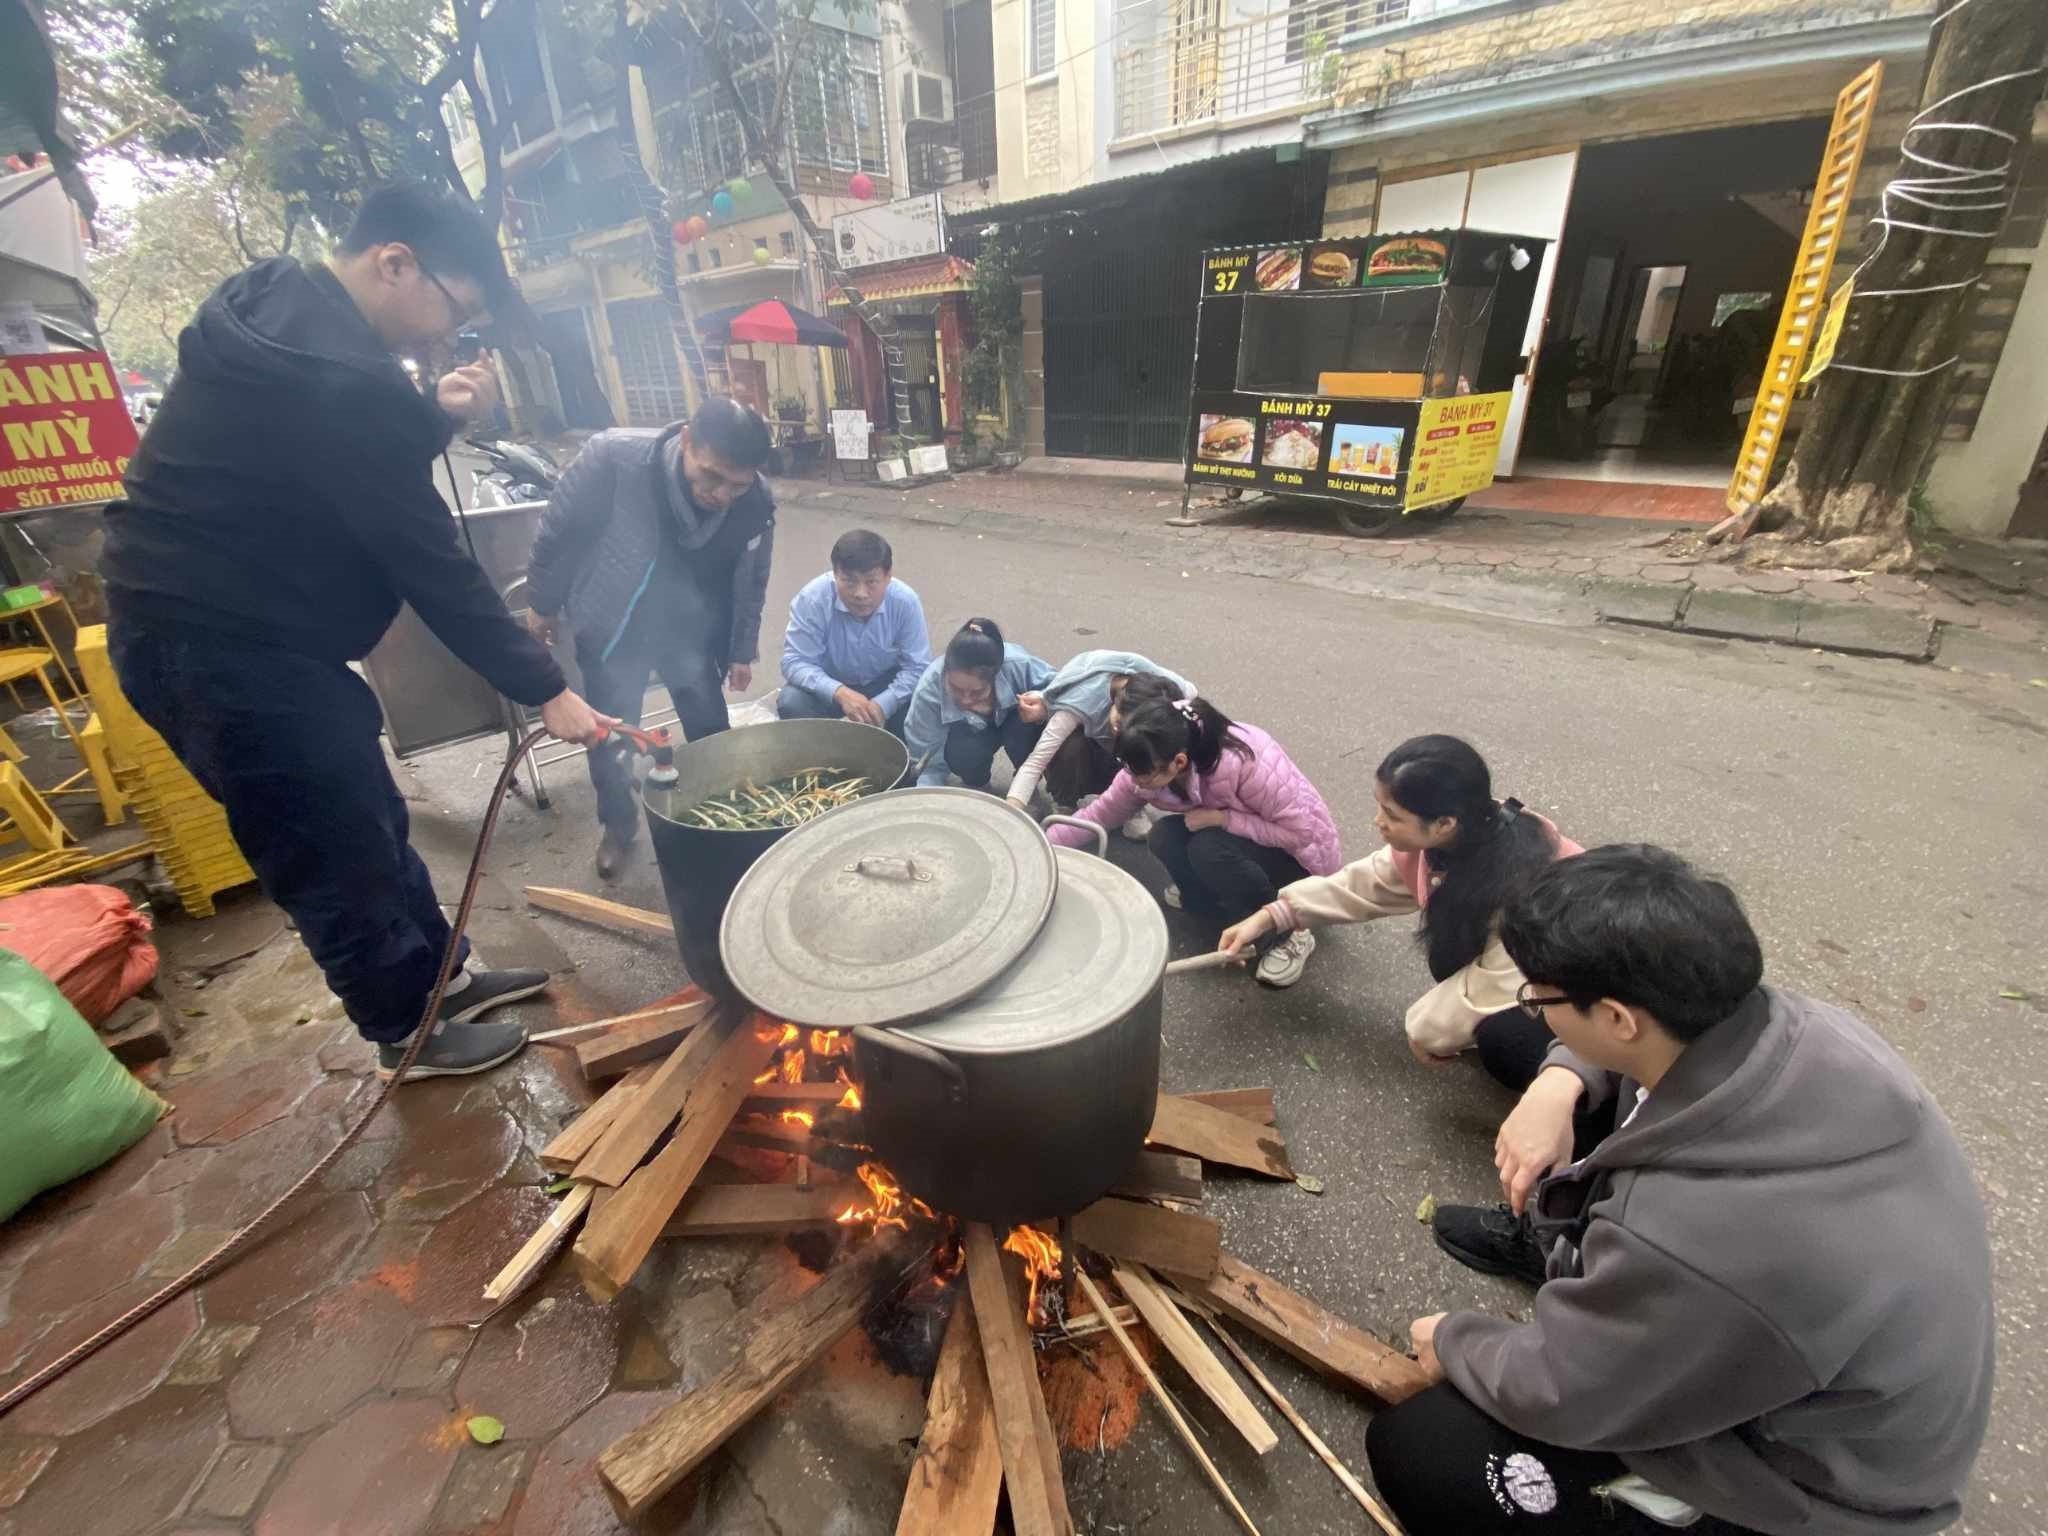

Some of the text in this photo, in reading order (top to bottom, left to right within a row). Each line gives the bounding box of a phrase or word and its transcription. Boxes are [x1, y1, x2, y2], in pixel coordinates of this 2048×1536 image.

[1215, 271, 1239, 291] 37
[0, 359, 115, 407] ÁNH
[1261, 398, 1293, 415] BÁNH
[1316, 404, 1331, 417] 37
[1482, 401, 1496, 417] 37
[2, 410, 93, 460] MỲ
[16, 480, 127, 508] SỐT PHOMA
